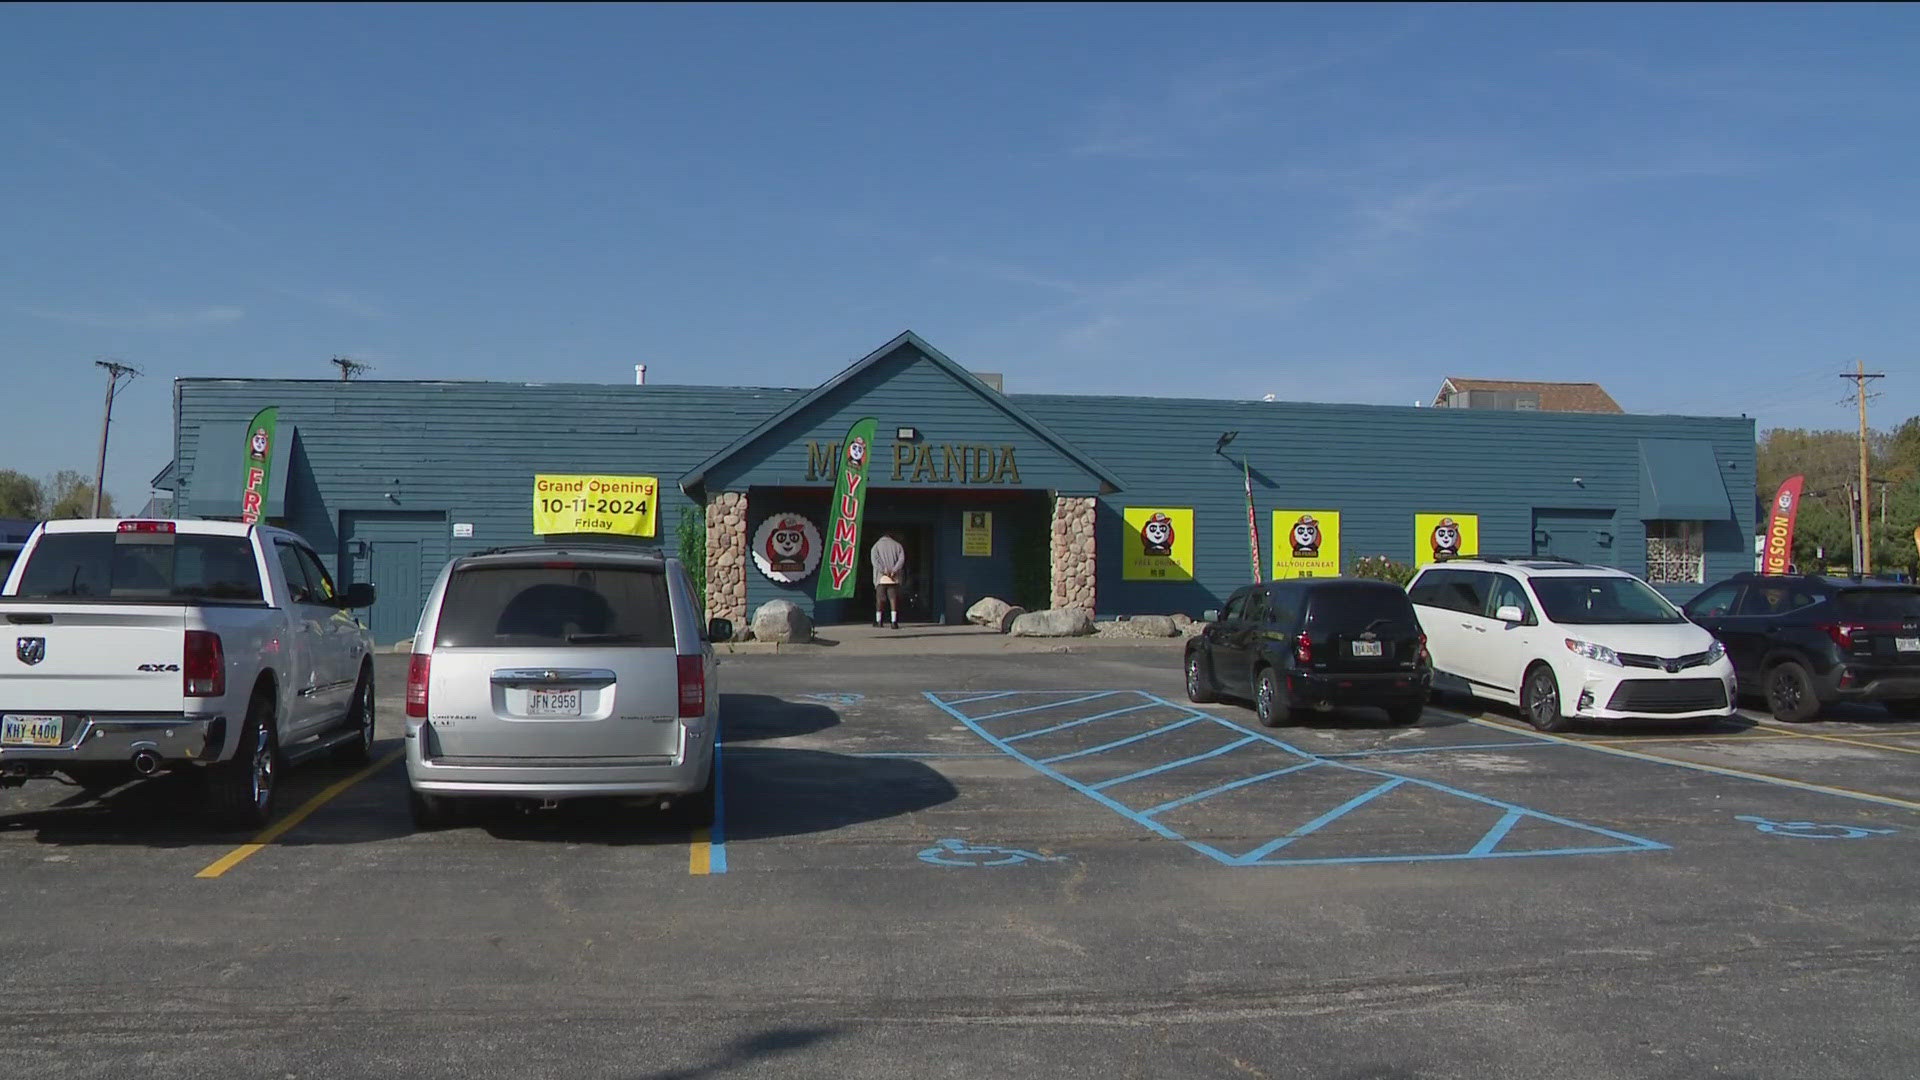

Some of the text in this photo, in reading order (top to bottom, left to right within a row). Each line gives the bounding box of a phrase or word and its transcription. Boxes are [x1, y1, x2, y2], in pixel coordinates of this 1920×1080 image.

[805, 441, 1022, 484] M PANDA
[537, 480, 654, 496] Grand Opening
[541, 498, 648, 516] 10-11-2024
[575, 518, 613, 529] Friday
[830, 470, 861, 591] YUMMY
[1769, 516, 1789, 556] SOON
[530, 695, 576, 709] JFN 2958
[6, 723, 57, 739] KHY 4400
